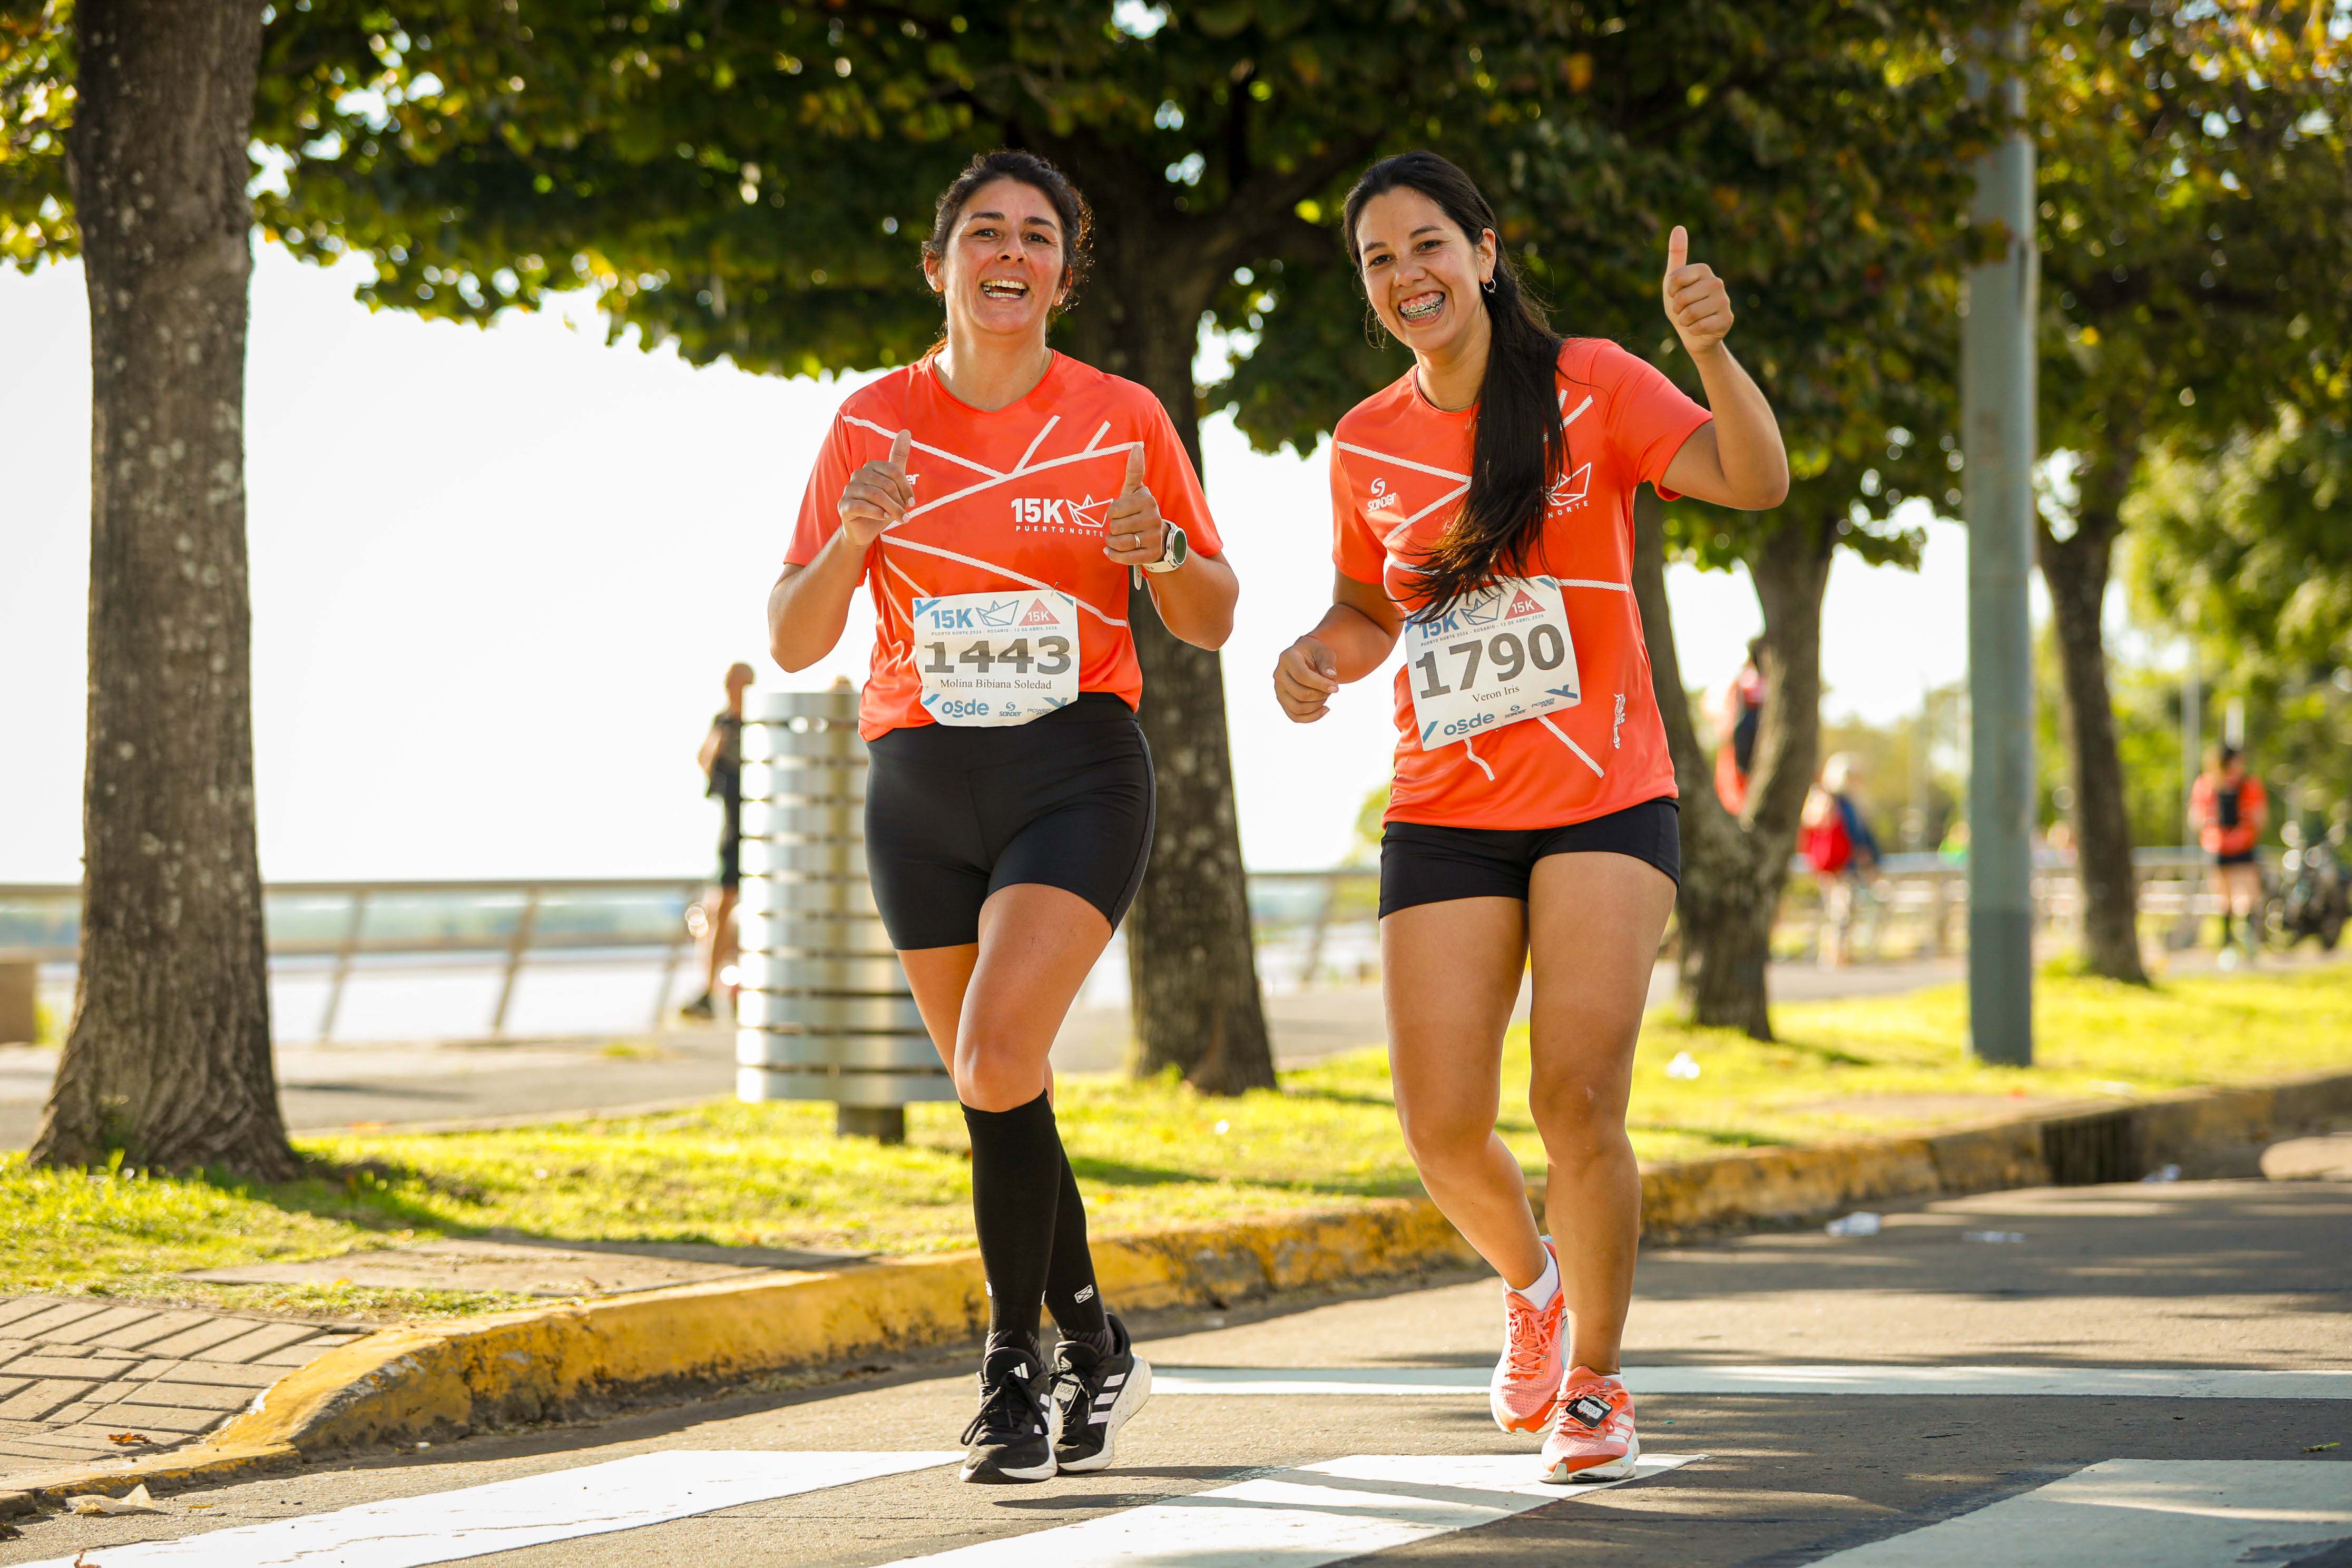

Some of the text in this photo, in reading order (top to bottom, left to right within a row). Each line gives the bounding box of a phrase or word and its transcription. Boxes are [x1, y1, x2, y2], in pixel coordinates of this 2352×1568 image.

[1011, 498, 1064, 524] 15K
[1547, 500, 1589, 518] NORTE
[1070, 527, 1103, 537] NORTE
[1512, 599, 1535, 614] 15K
[930, 607, 974, 629] 15K
[1027, 611, 1050, 622] 15K
[1419, 610, 1459, 639] 15K
[1420, 639, 1438, 647] PUERTO
[924, 635, 1071, 675] 1443
[1415, 623, 1565, 699] 1790
[940, 679, 1052, 689] Molina Bibiana Soledad
[1472, 685, 1520, 702] Veron Iris
[942, 698, 989, 718] osde
[1444, 712, 1495, 736] osde
[1057, 1385, 1073, 1395] 1006
[1580, 1403, 1598, 1414] 3103
